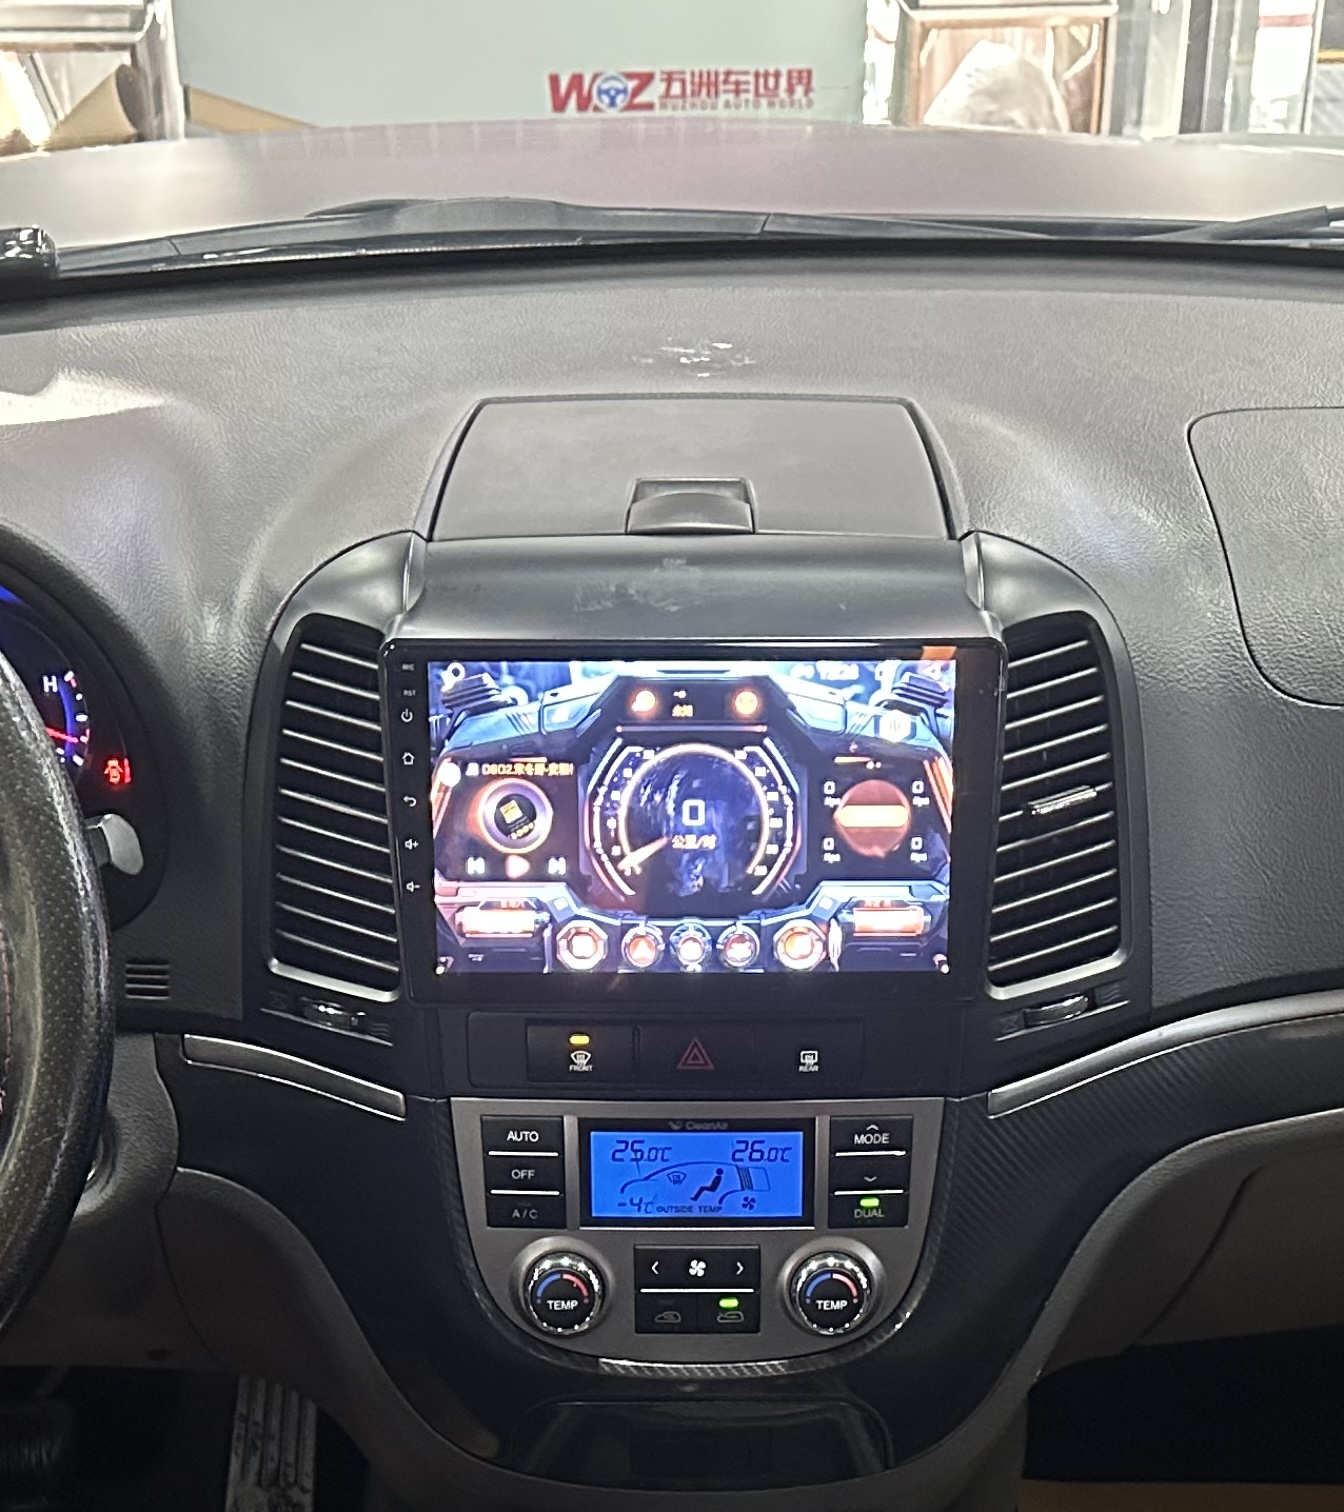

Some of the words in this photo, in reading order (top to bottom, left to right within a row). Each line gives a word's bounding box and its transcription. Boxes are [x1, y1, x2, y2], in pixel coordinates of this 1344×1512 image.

[659, 68, 815, 99] 五洲车世界
[723, 99, 761, 110] AUTO
[42, 675, 58, 693] H
[682, 799, 705, 826] 0
[798, 1064, 819, 1072] REAR
[506, 1130, 539, 1142] AUTO
[854, 1133, 890, 1145] MODE
[511, 1169, 535, 1180] OFF
[656, 1205, 694, 1213] OUTSIDE
[698, 1205, 723, 1213] TEMP
[853, 1208, 886, 1219] DUAL
[546, 1300, 578, 1311] TEMP
[816, 1300, 847, 1311] TEMP
